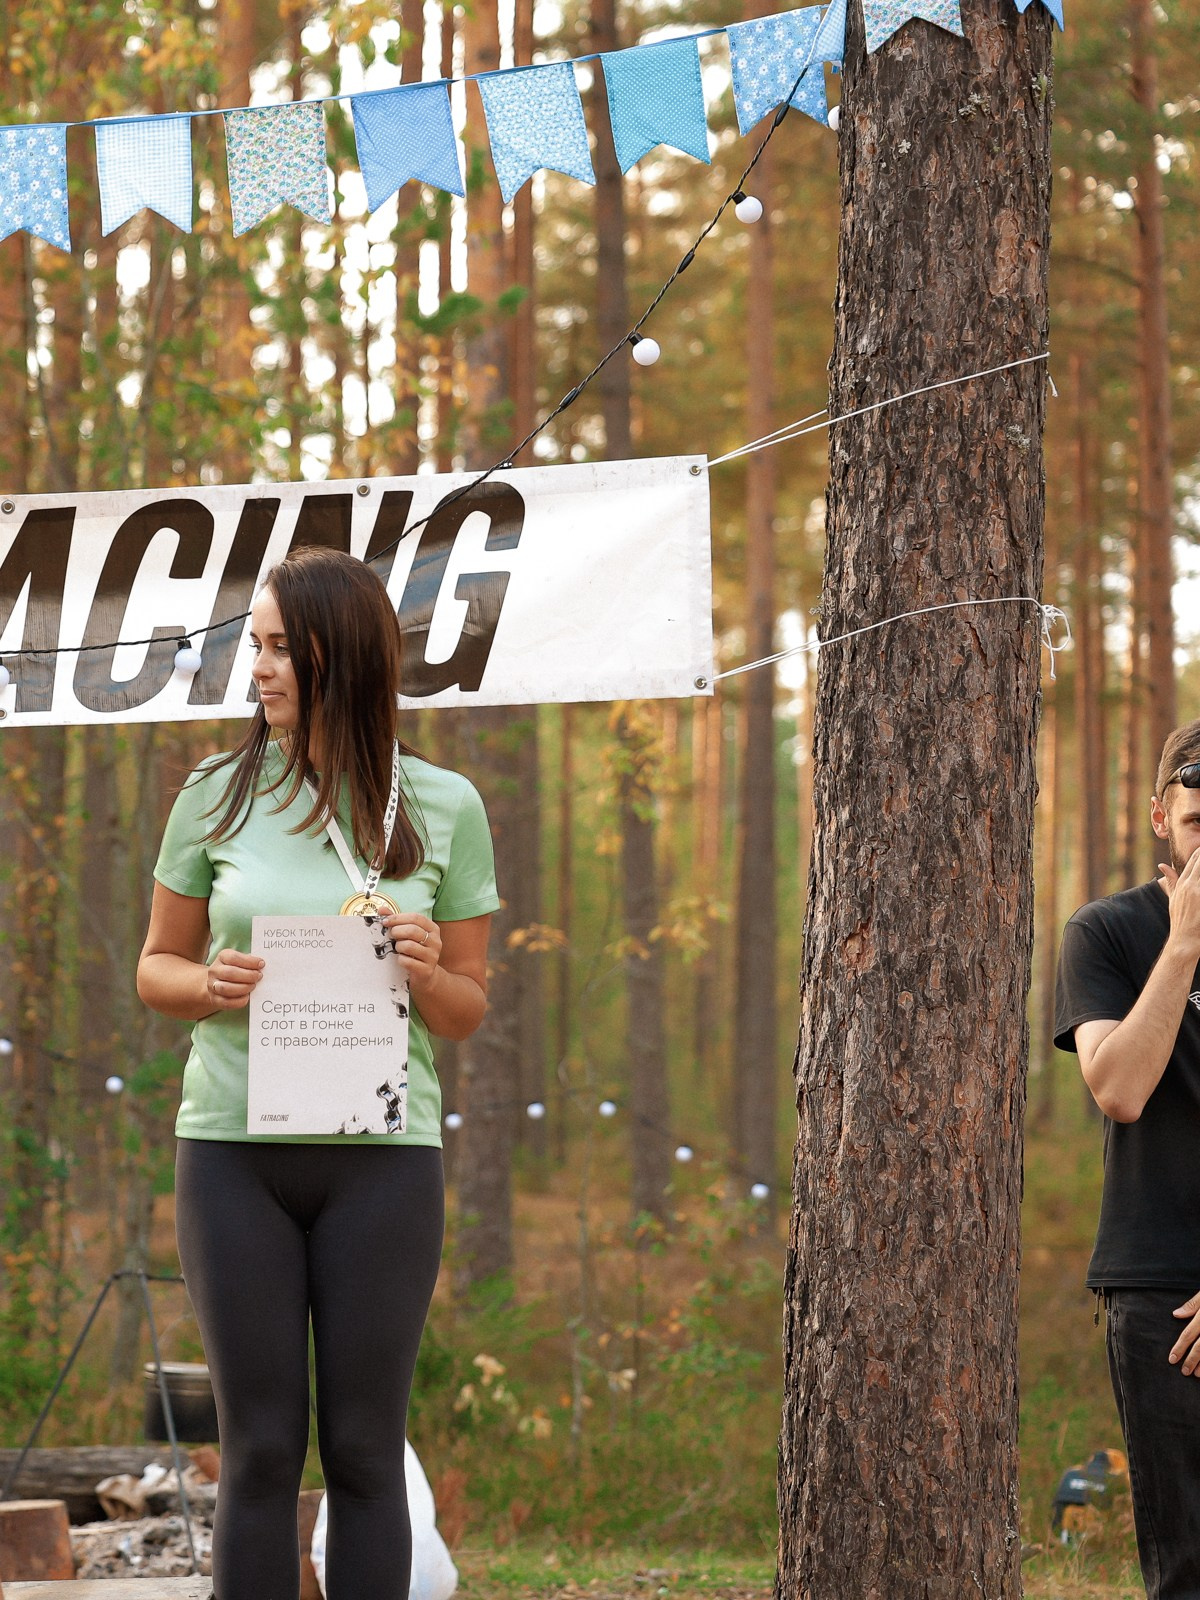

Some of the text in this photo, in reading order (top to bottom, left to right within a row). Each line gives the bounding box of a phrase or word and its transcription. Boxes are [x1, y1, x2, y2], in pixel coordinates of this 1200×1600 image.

[263, 928, 325, 938] КУБОК ТИПА
[263, 939, 334, 949] ЦИКЛОКРОСС
[261, 1000, 375, 1017] Сертификат на
[261, 1020, 354, 1030] слот в гонке
[260, 1036, 393, 1050] с правом дарения
[259, 1114, 289, 1122] FATRACING
